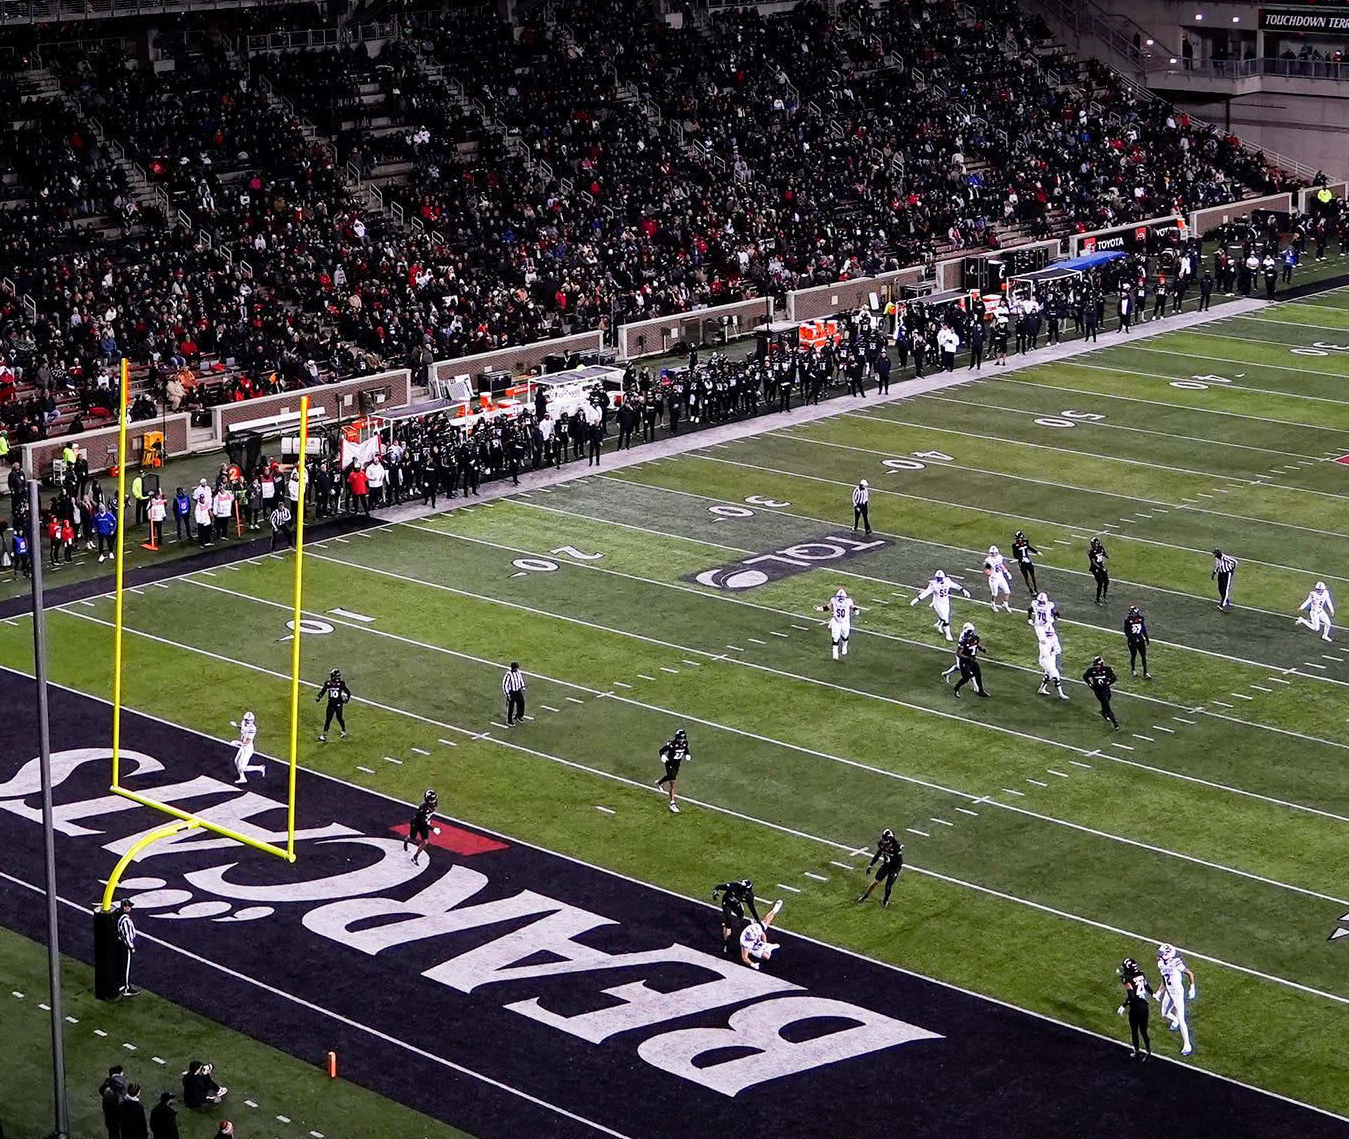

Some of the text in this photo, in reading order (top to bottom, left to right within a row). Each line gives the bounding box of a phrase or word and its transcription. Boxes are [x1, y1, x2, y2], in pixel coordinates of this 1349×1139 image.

[1266, 14, 1326, 28] TOUCHDOWN
[1097, 237, 1124, 250] TOYOTA
[1167, 374, 1233, 391] 40
[1032, 409, 1104, 429] 50
[881, 450, 956, 471] 40
[707, 494, 791, 518] 30
[512, 544, 605, 572] 20
[742, 535, 887, 570] TQL
[285, 607, 377, 635] 10
[836, 608, 846, 619] 50
[1131, 623, 1142, 634] 97
[330, 690, 339, 699] 10
